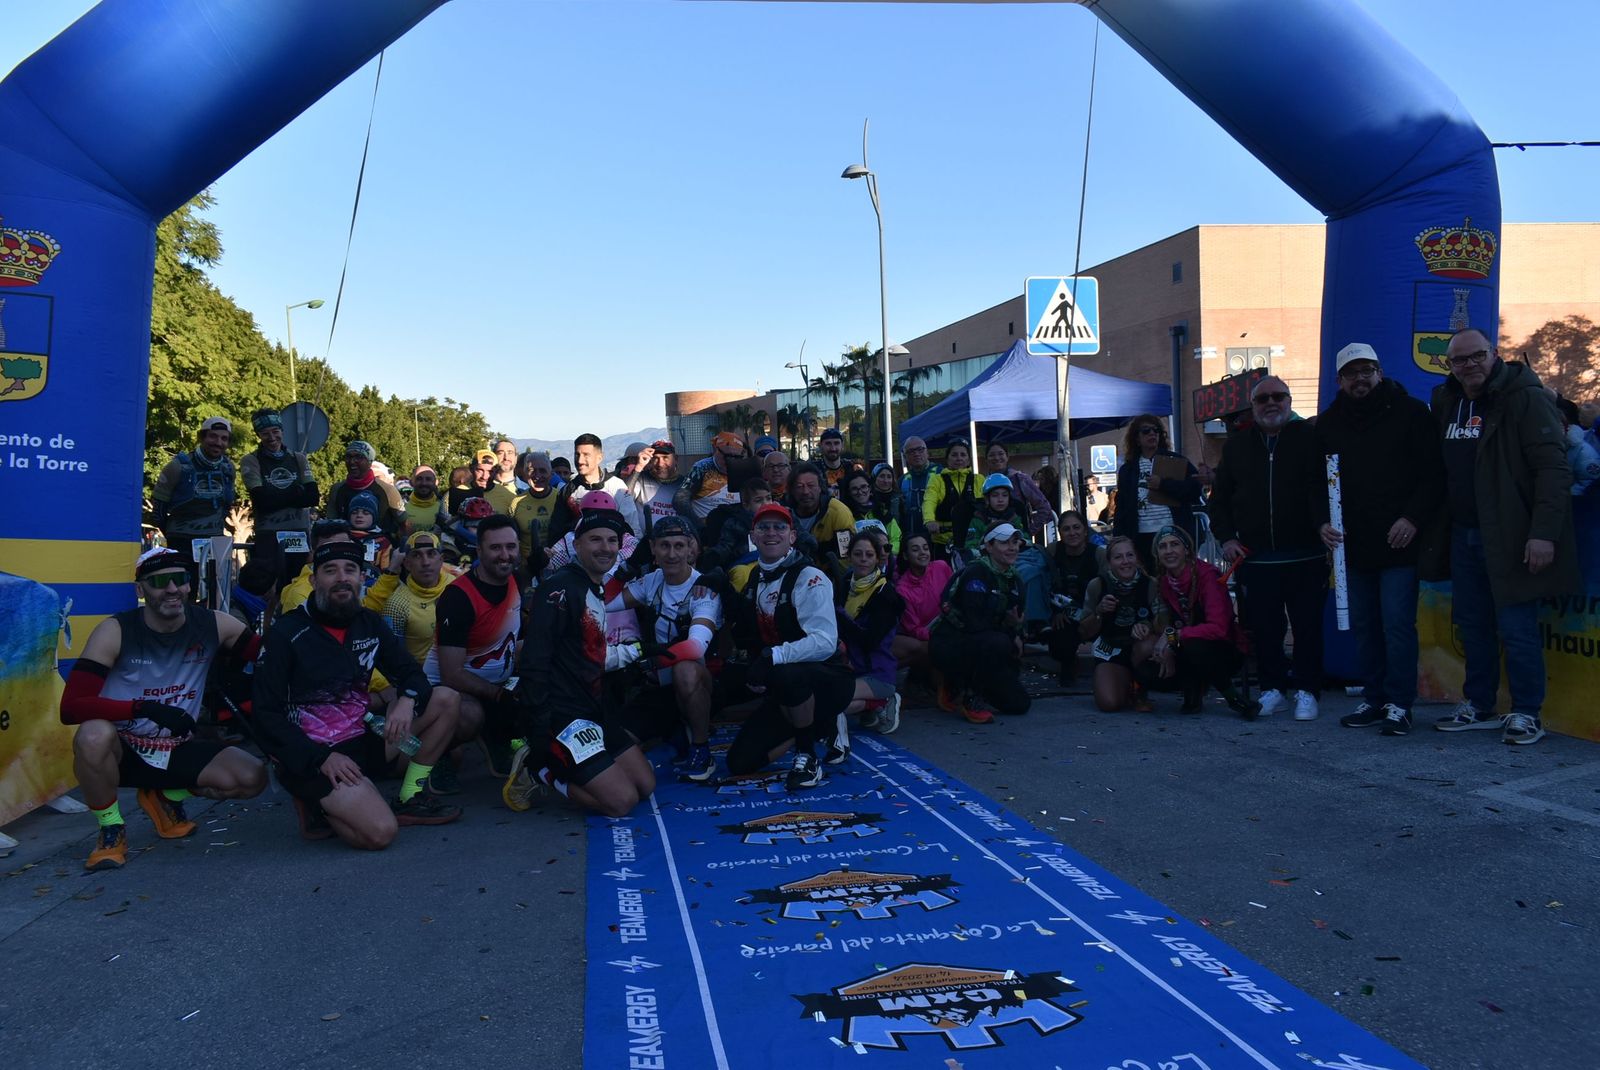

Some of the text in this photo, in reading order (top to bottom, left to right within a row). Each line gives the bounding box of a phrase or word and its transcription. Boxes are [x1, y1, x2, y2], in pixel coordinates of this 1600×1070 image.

[1444, 422, 1481, 440] lless
[49, 433, 75, 449] de
[9, 452, 29, 468] la
[36, 454, 89, 472] Torre
[284, 538, 303, 547] 002
[1538, 622, 1600, 658] lhau
[143, 683, 186, 697] EQUIPO
[573, 727, 602, 747] 1007
[786, 854, 813, 865] del
[817, 845, 913, 860] Conquista
[1031, 852, 1122, 901] TEAMERGY
[617, 887, 649, 944] TEAMERGY
[880, 923, 1002, 945] Conquista
[841, 937, 875, 953] del
[1150, 933, 1296, 1015] TEAMERGY
[903, 987, 923, 995] DE
[992, 979, 1025, 987] TRAIL
[840, 991, 883, 1001] TORRE
[885, 989, 903, 998] LA
[625, 984, 667, 1070] EAMERGY
